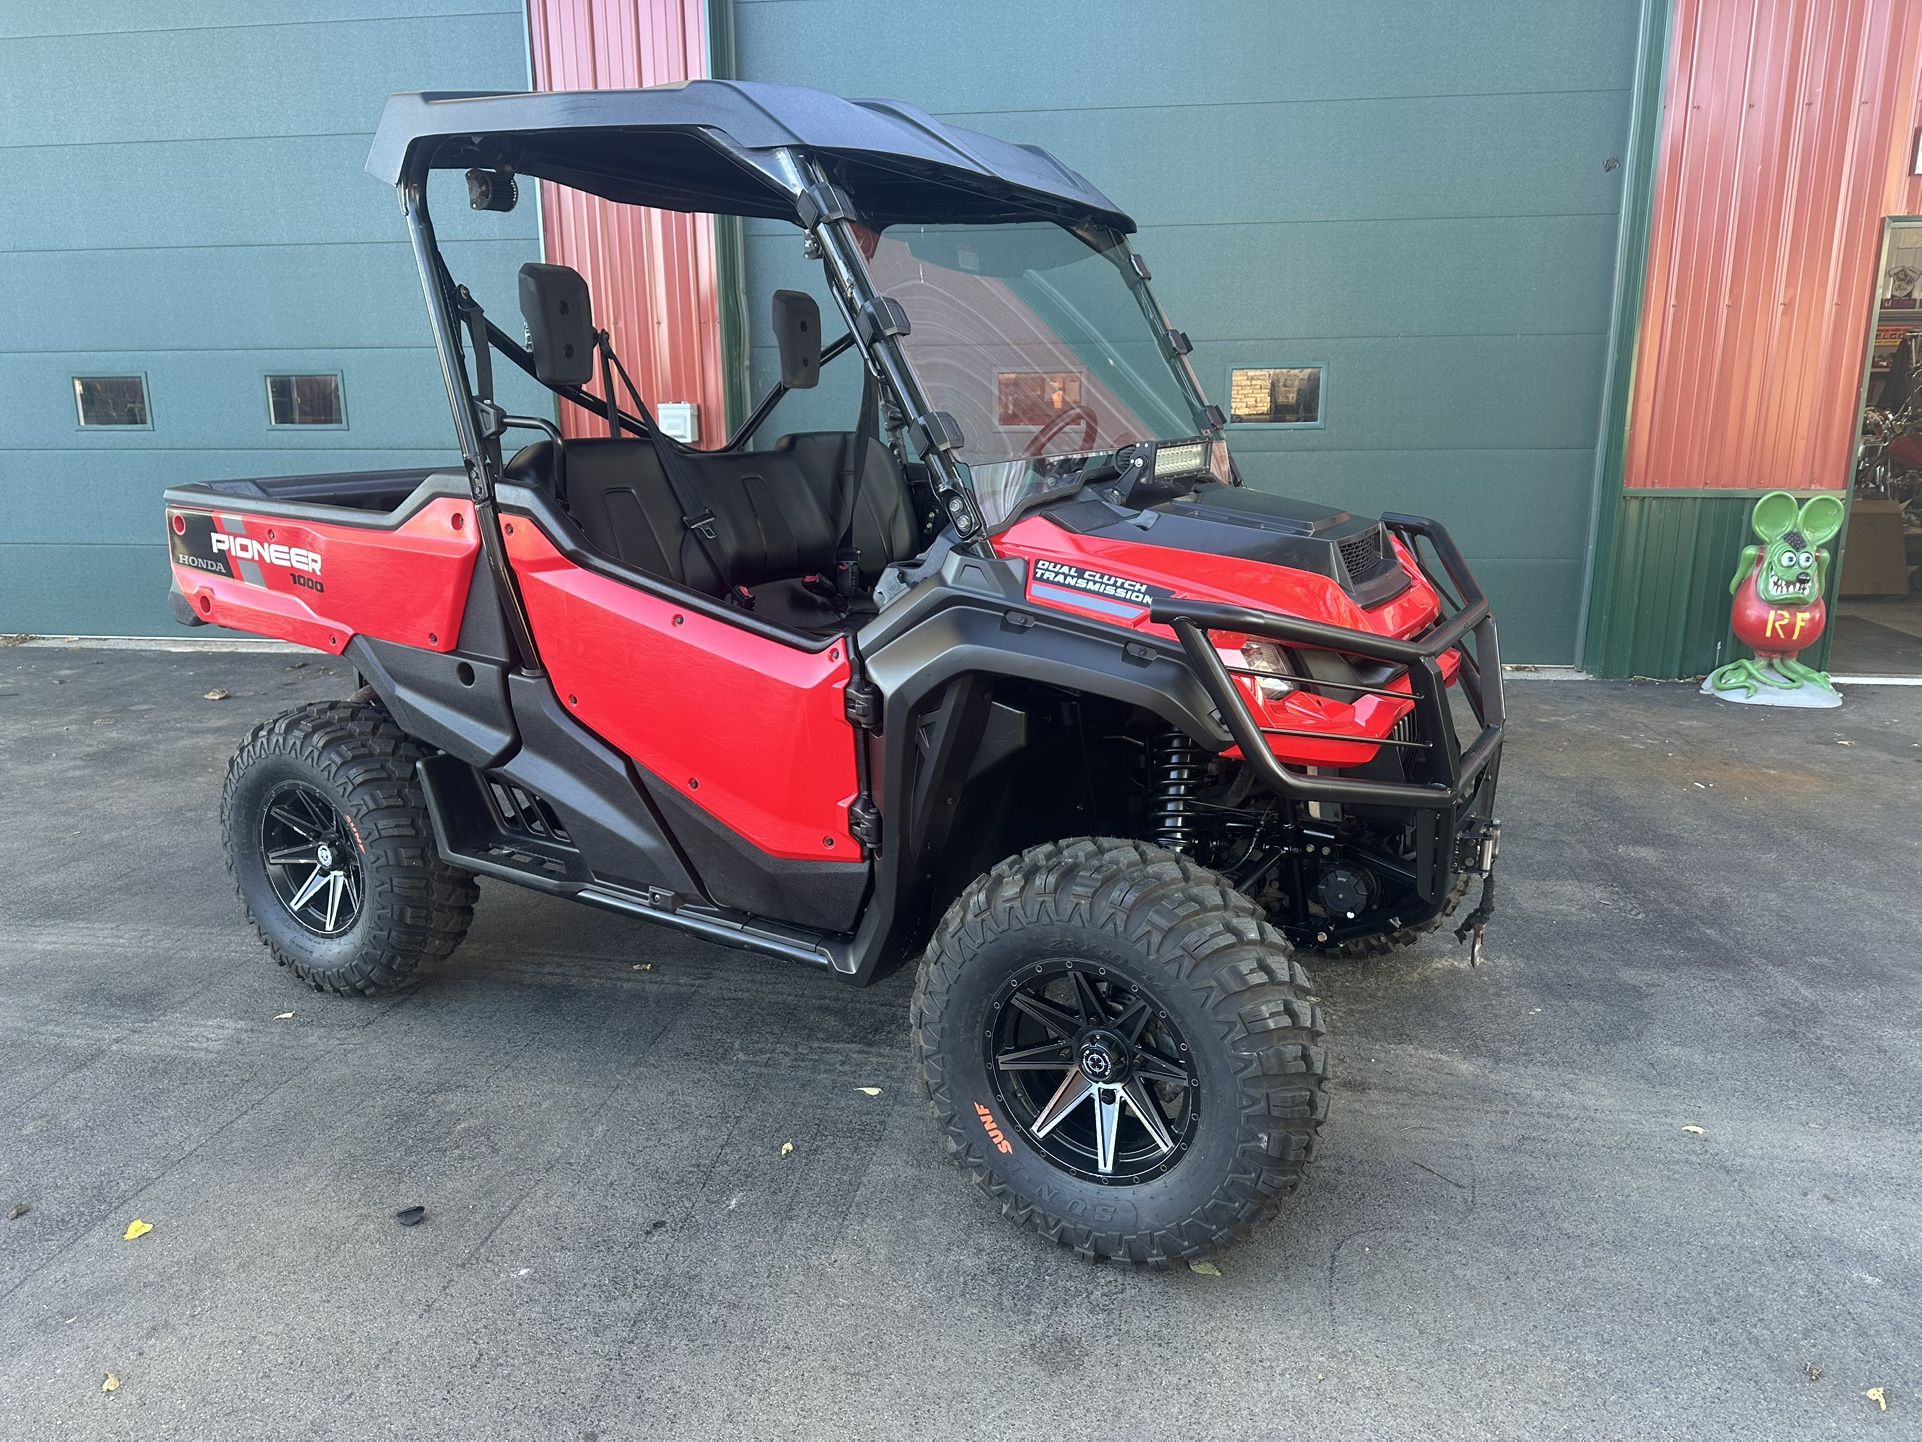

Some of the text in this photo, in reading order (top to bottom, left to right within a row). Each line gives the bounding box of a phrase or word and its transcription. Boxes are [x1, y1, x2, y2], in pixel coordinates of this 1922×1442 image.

[178, 553, 226, 573] HONDA
[210, 532, 322, 575] PIONEER
[290, 573, 324, 593] 1000
[1035, 569, 1152, 605] TRANSMISSION
[1037, 560, 1147, 593] DUAL CLUTCH
[1765, 609, 1810, 640] RF
